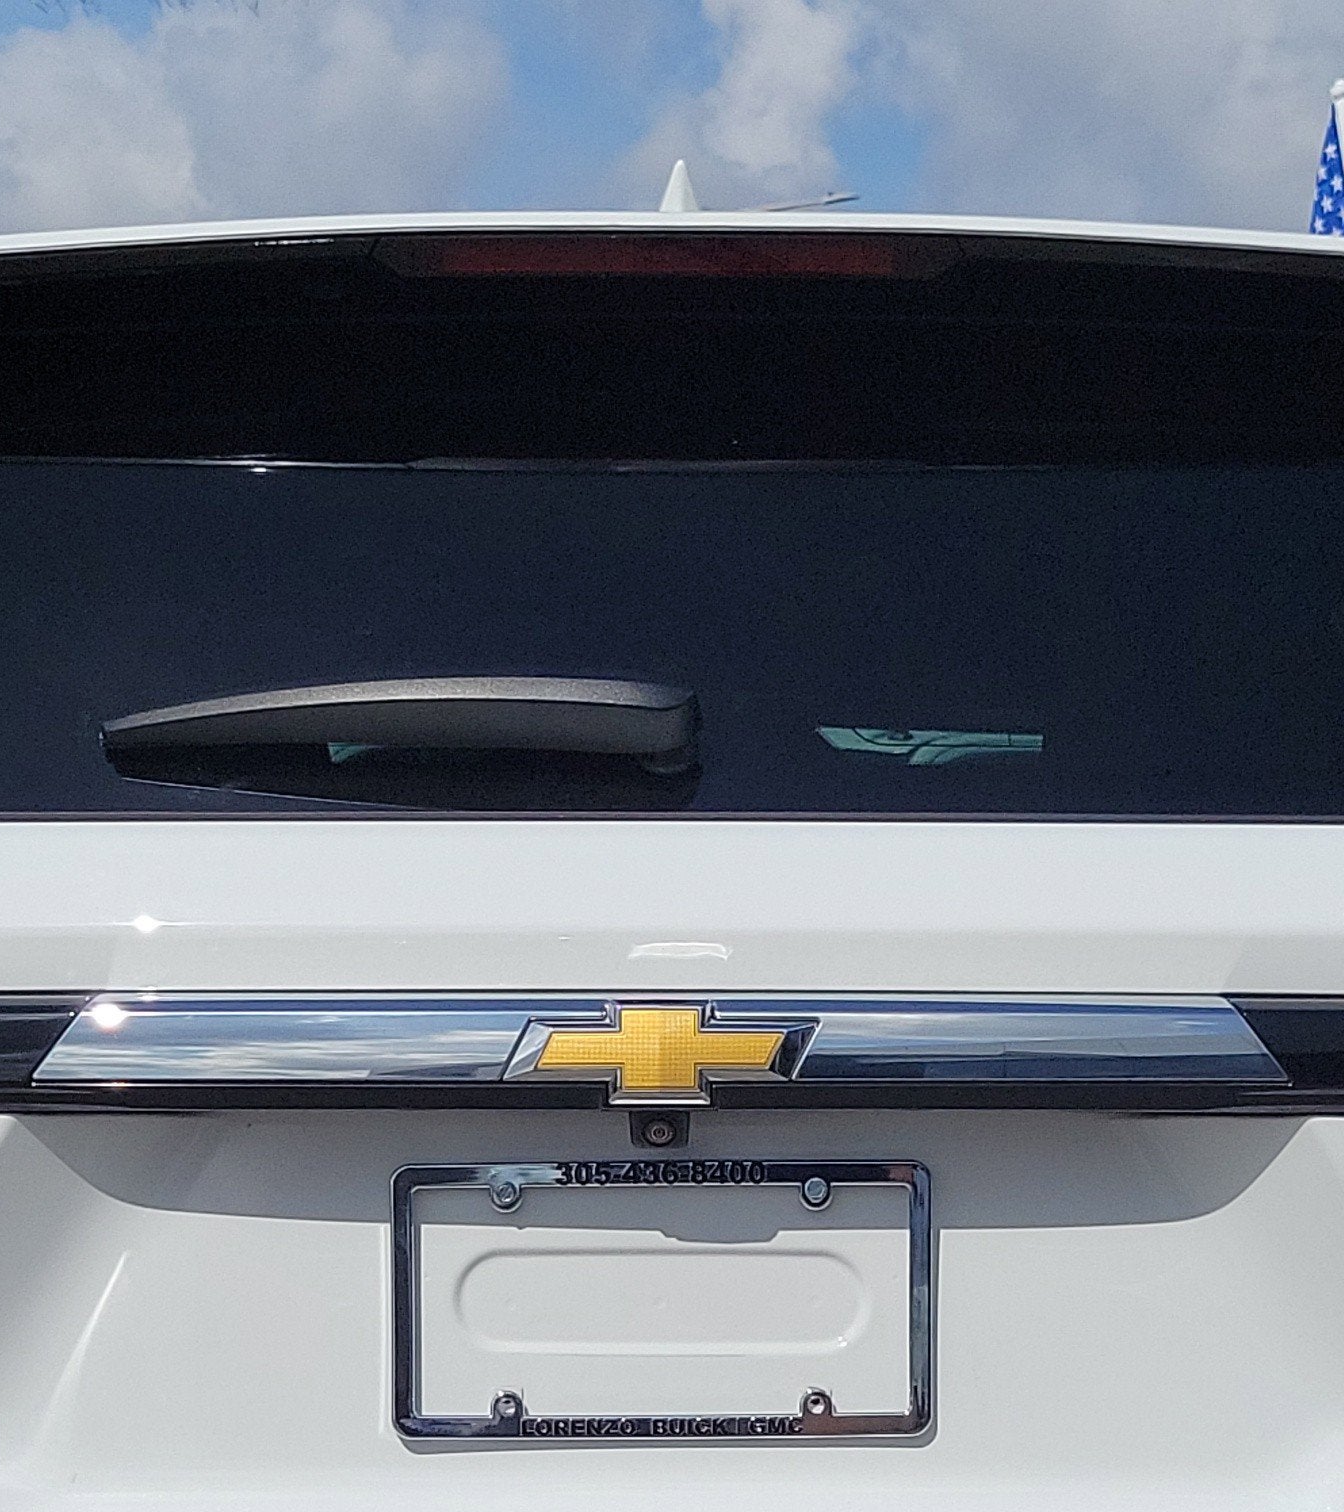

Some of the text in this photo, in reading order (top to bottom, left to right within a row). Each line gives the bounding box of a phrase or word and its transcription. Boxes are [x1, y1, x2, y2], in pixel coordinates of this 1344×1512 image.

[555, 1160, 766, 1185] 305-436-8400
[519, 1416, 639, 1437] LORENZO
[651, 1416, 731, 1436] BUICK
[747, 1416, 805, 1436] GMC
